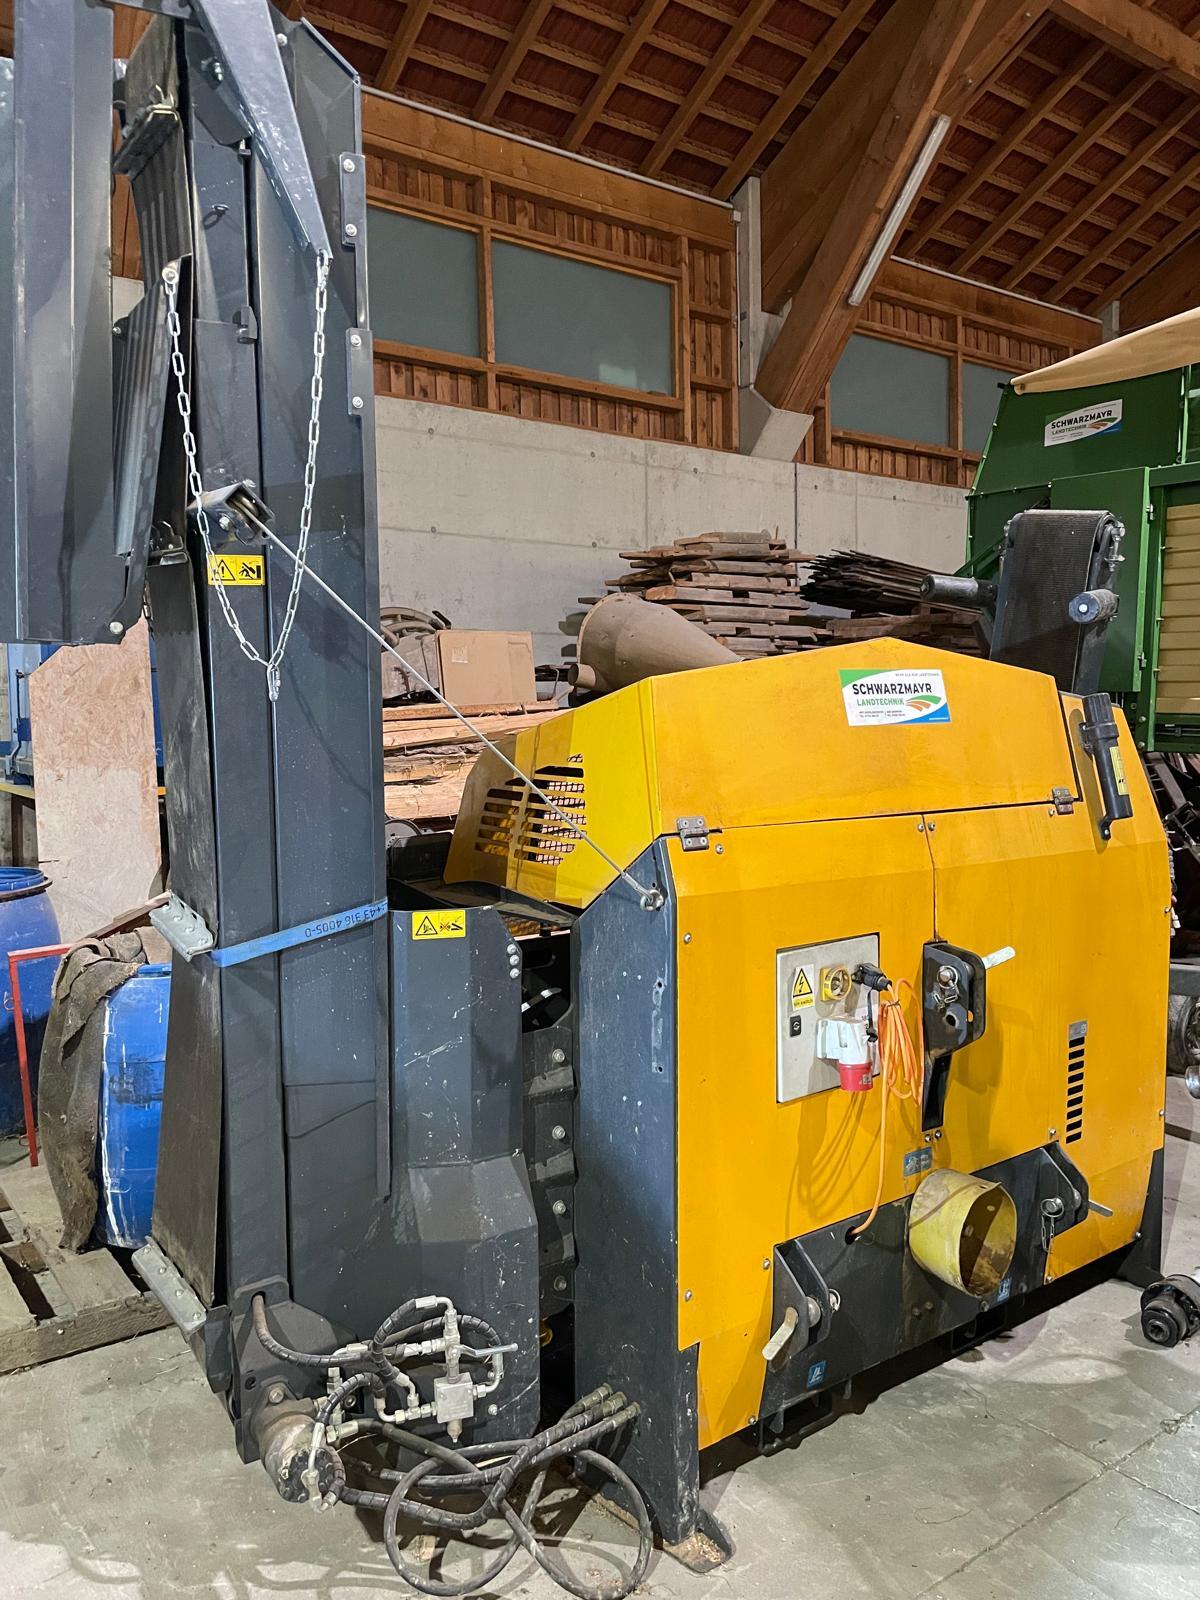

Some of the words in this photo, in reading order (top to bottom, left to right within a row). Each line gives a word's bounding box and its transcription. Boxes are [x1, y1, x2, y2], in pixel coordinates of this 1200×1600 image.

[1051, 410, 1113, 430] SCHWARZMAYR
[852, 683, 932, 695] SCHWARZMAYR
[856, 697, 905, 706] LANDTECHNIK
[344, 912, 361, 926] 316
[304, 920, 342, 938] 4005-0
